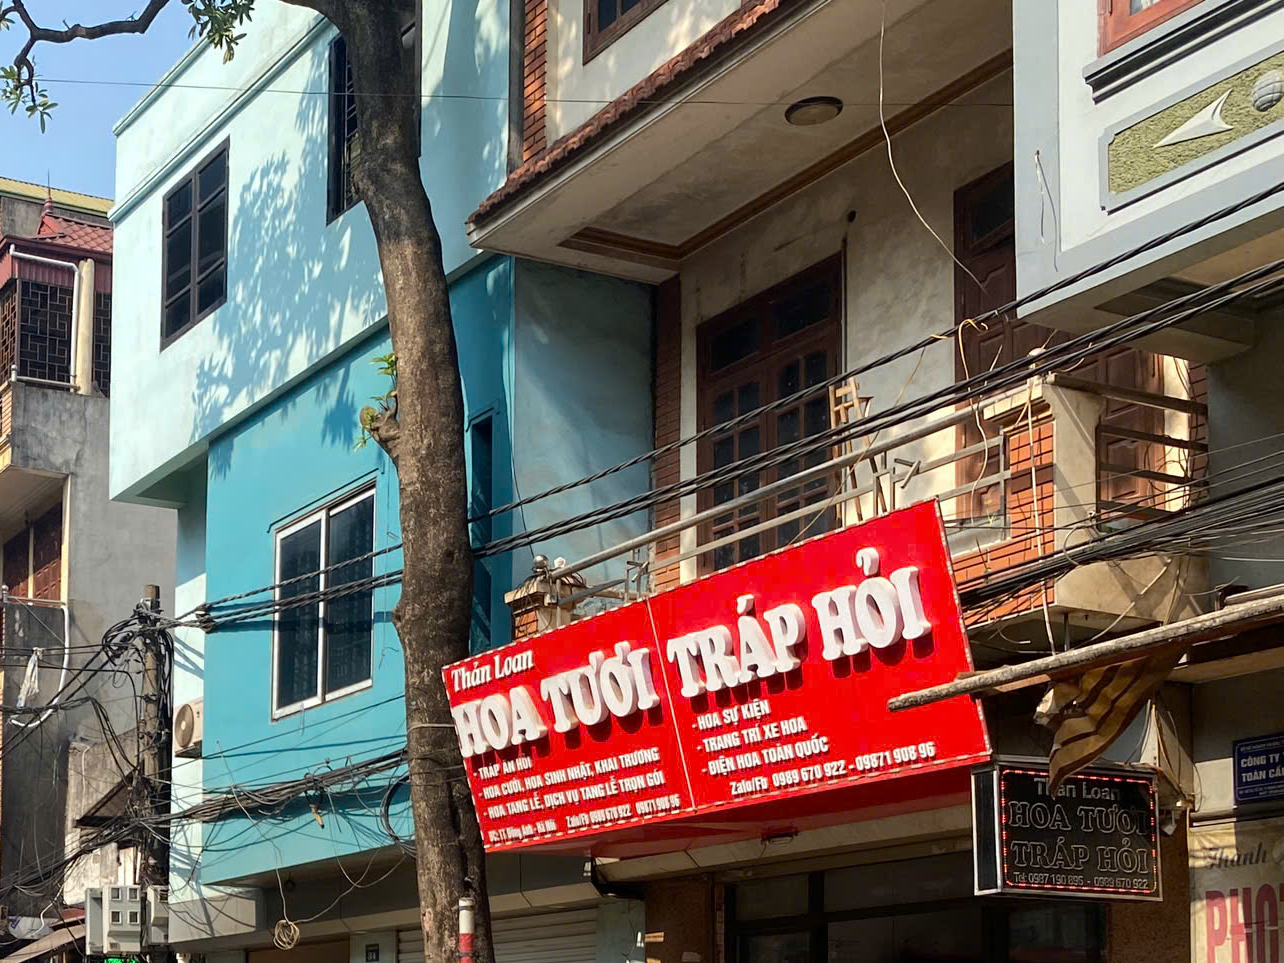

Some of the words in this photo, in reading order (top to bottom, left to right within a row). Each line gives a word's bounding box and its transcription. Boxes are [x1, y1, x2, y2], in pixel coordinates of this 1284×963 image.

[452, 685, 548, 758] HOA
[667, 594, 806, 698] TRÁP
[812, 547, 932, 661] HỎI
[494, 649, 534, 680] Loan
[697, 711, 722, 730] HOA
[722, 706, 739, 725] SỰ
[740, 698, 771, 719] KIỆN
[702, 731, 741, 752] TRANG
[741, 723, 761, 744] TRÍ
[763, 722, 780, 740] XE
[780, 716, 808, 735] HOA
[708, 755, 736, 775] ĐIỆN
[736, 751, 761, 769] HOA
[761, 743, 794, 764] TOÀN
[795, 733, 829, 758] QUỐC
[729, 776, 769, 795] Zalo/Fb
[772, 769, 799, 787] 0989
[801, 764, 822, 781] 670
[824, 760, 847, 777] 922
[856, 751, 892, 770] 09871
[893, 745, 917, 763] 908
[918, 741, 936, 758] 96
[483, 784, 501, 799] HOA
[524, 774, 543, 790] HOA
[544, 769, 567, 785] SINH
[594, 757, 619, 774] KHAI
[488, 804, 506, 819] HOA
[506, 799, 529, 815] TANG
[580, 784, 605, 800] TANG
[646, 768, 665, 787] GÓI
[1008, 801, 1071, 831] HOA
[1096, 837, 1148, 874] HỎI
